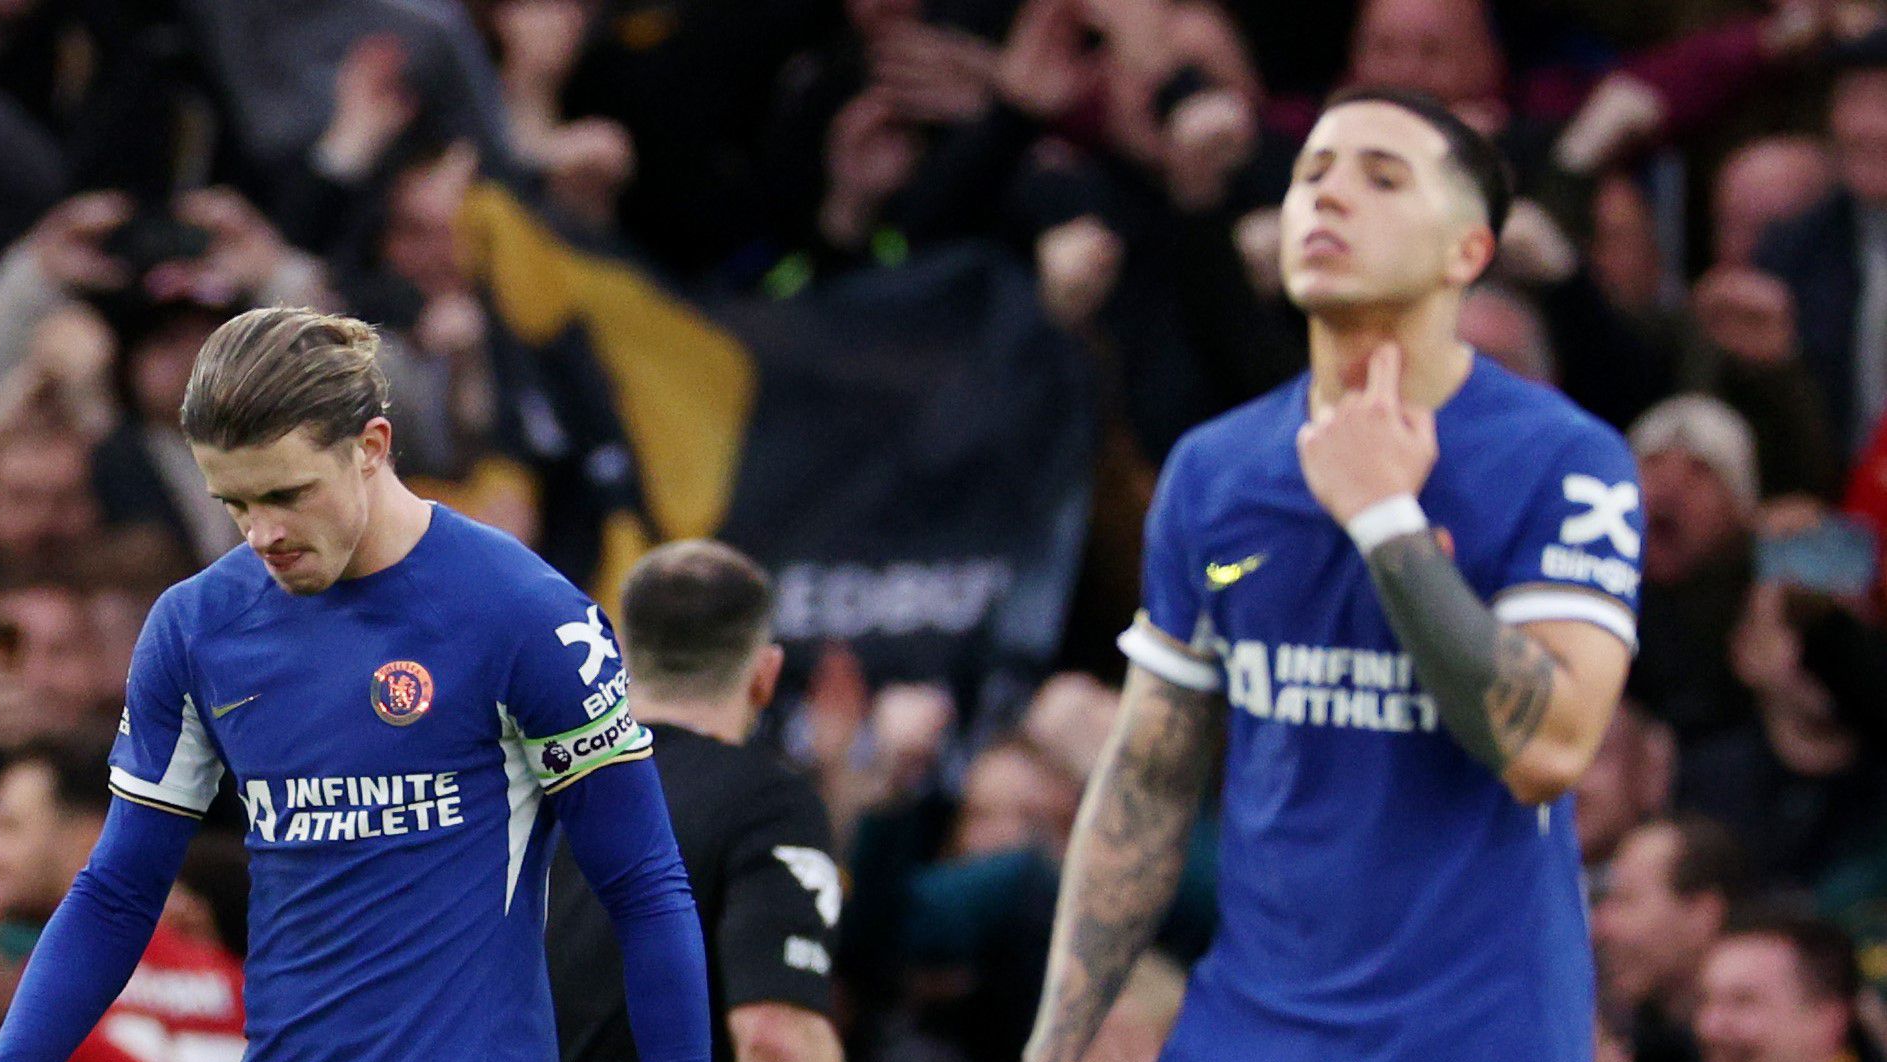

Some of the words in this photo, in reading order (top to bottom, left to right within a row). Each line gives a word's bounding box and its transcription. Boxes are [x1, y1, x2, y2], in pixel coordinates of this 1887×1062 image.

[1274, 641, 1412, 690] INFINI
[582, 667, 631, 720] Bing
[1274, 685, 1438, 733] ATHLET
[573, 713, 633, 757] Capta
[286, 771, 459, 809] INFINITE
[284, 796, 464, 842] ATHLETE
